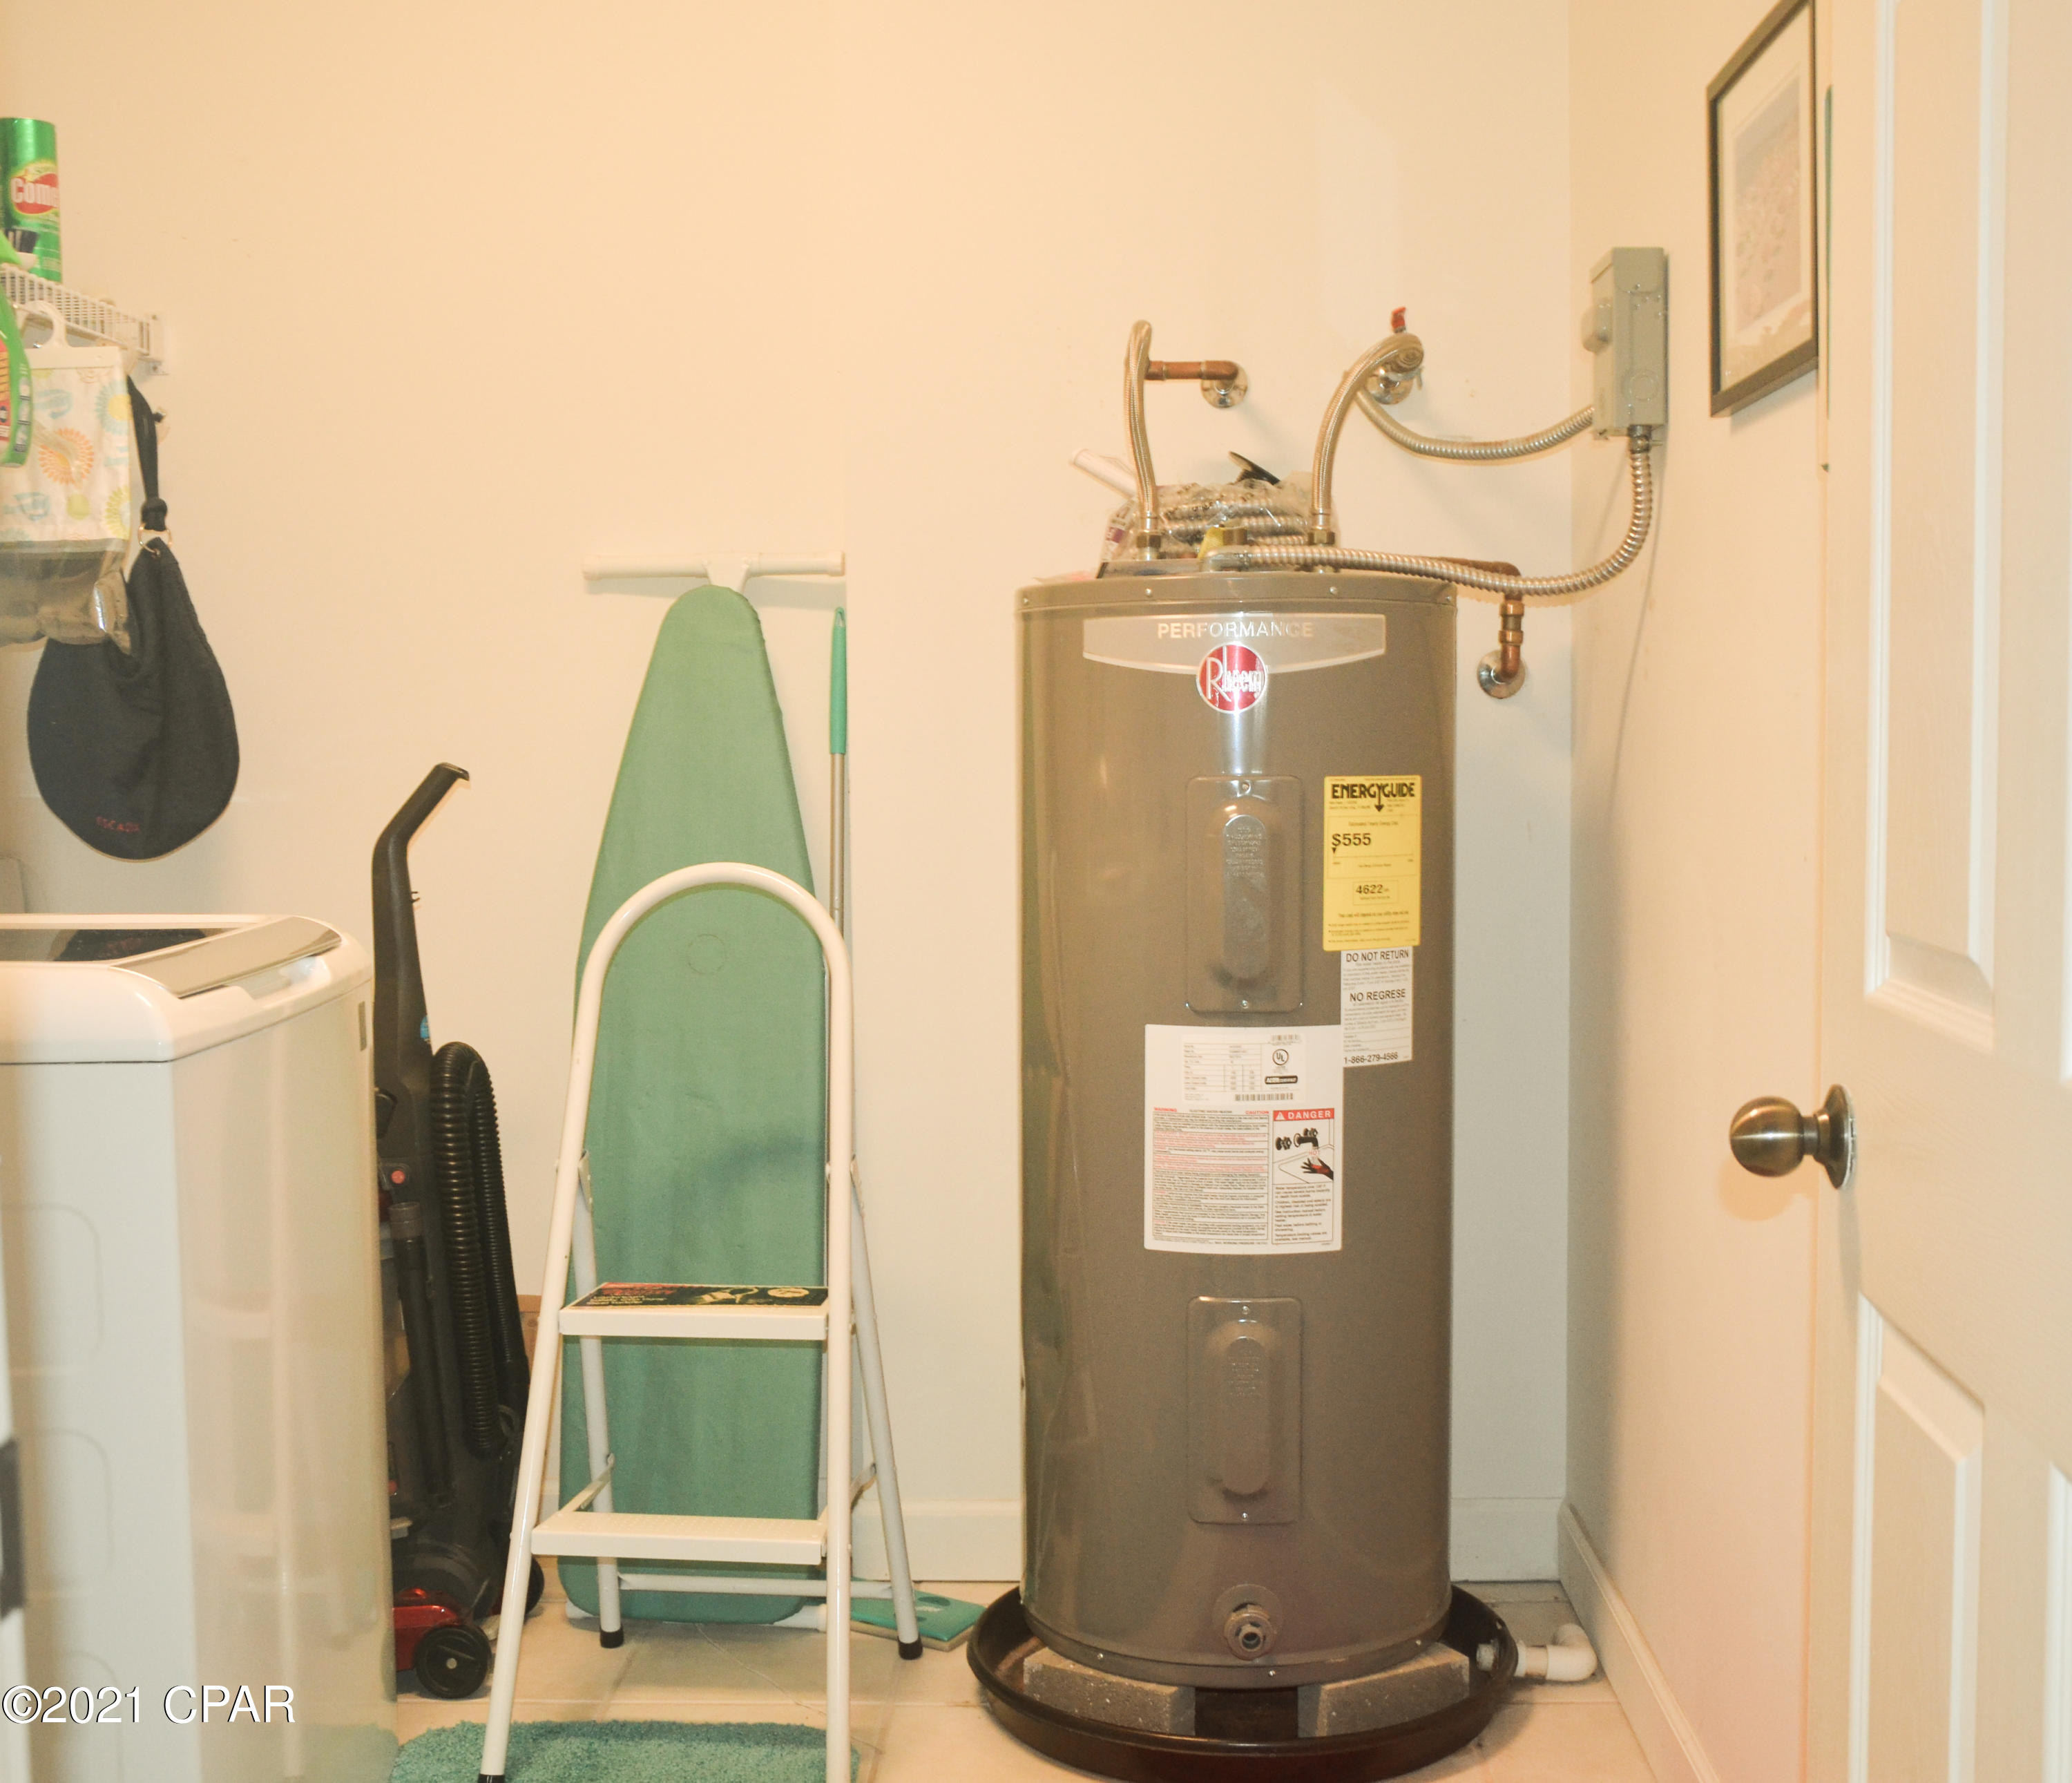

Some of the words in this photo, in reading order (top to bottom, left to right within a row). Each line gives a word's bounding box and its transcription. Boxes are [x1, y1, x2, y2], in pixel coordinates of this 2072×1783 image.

[1158, 622, 1315, 638] PERFORMANCE
[1205, 645, 1263, 703] Rheem
[1331, 782, 1415, 799] ENERGYGUIDE
[1332, 833, 1371, 847] $555
[1356, 884, 1383, 894] 4622
[1345, 953, 1359, 962] DO
[1361, 951, 1379, 962] NOT
[1380, 949, 1410, 960] RETURN
[1350, 993, 1364, 1002] NO
[1366, 989, 1406, 1000] REGRESE
[1276, 1052, 1285, 1062] UL
[1287, 1110, 1331, 1119] DANGER
